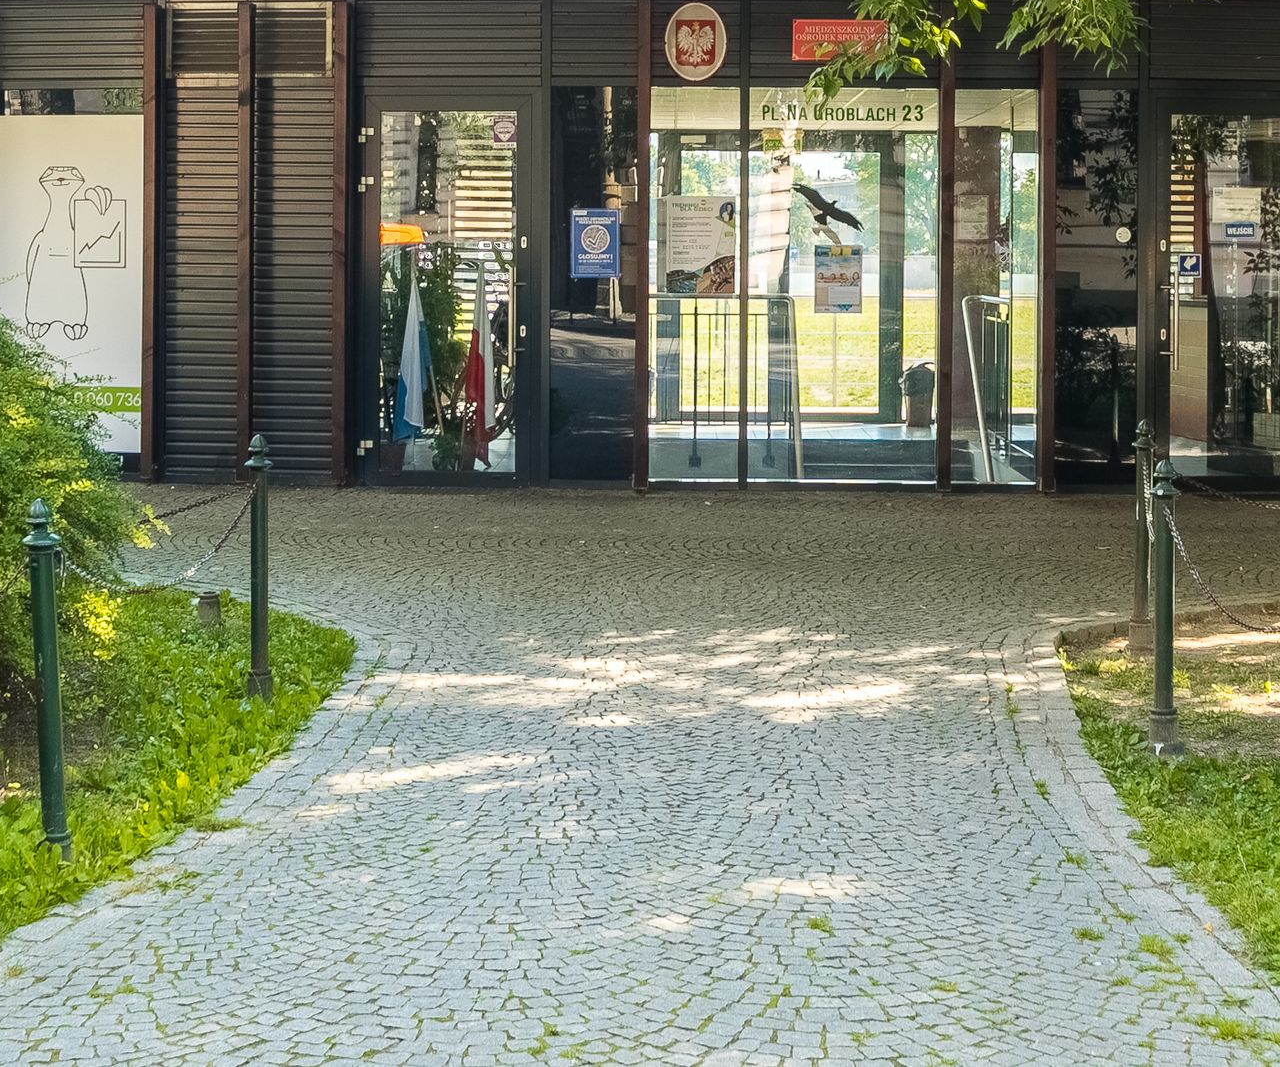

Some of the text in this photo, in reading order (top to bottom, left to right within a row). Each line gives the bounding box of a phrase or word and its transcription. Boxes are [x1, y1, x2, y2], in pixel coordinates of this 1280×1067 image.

[814, 104, 896, 122] GROBLACH
[902, 104, 924, 122] 23
[1226, 225, 1254, 235] WEJŚCIE
[116, 392, 141, 407] 736
